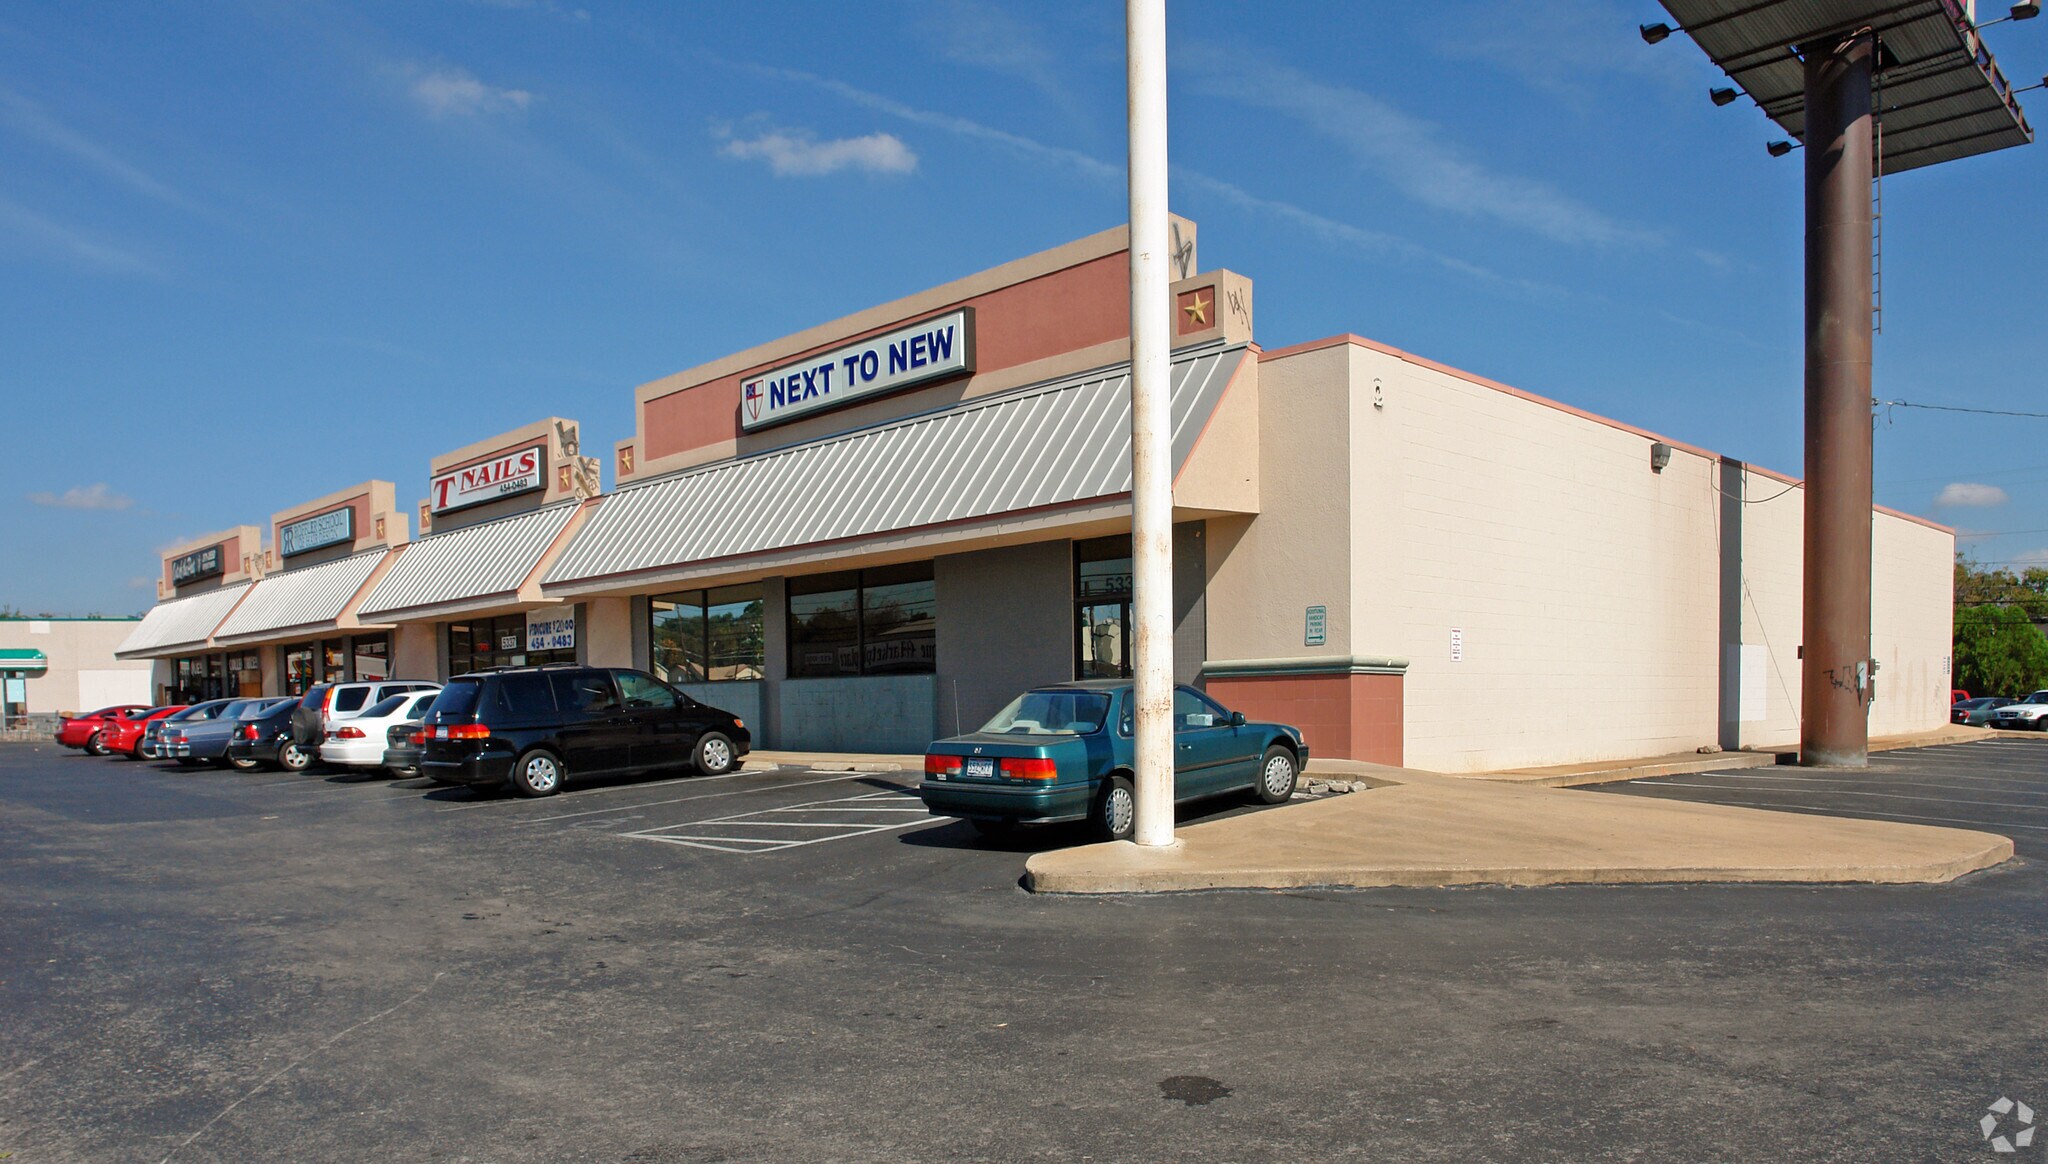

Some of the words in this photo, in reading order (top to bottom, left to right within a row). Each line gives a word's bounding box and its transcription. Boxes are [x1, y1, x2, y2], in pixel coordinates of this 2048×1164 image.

[770, 362, 835, 410] NEXT
[843, 350, 879, 386] TO
[889, 325, 954, 374] NEW
[434, 476, 456, 509] T
[460, 452, 535, 491] NAILS
[500, 478, 528, 494] 454-0483
[318, 513, 343, 531] SCHOOL
[528, 621, 552, 637] PEDICURE
[503, 636, 516, 648] 5337
[531, 637, 545, 650] 454
[551, 634, 572, 648] 0483
